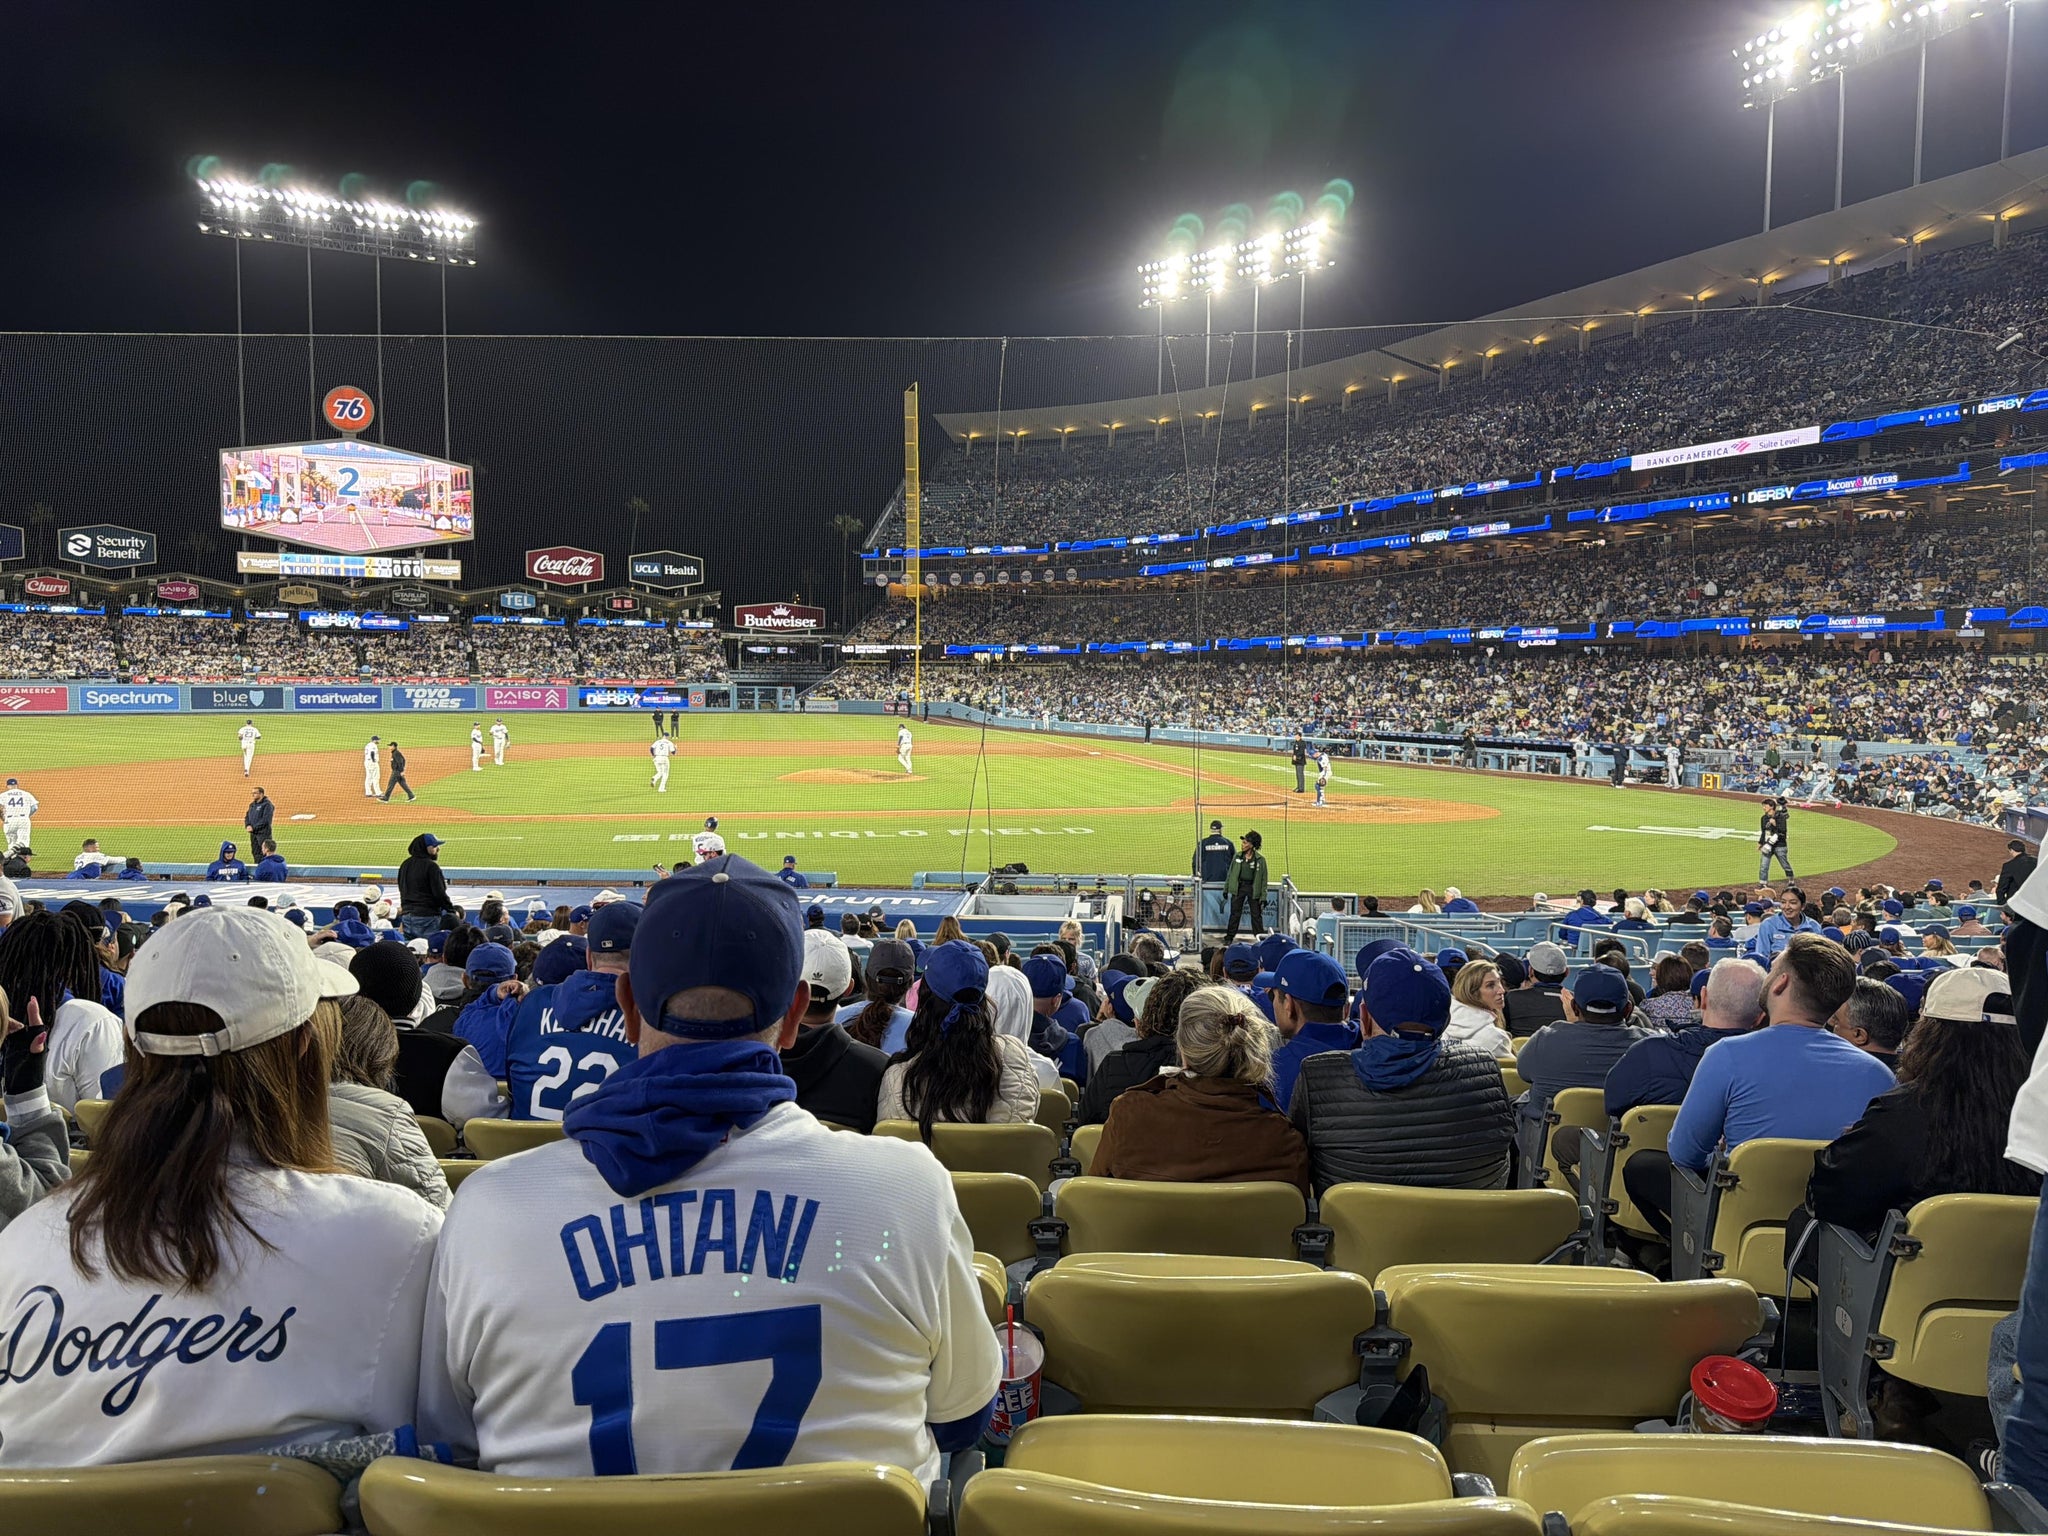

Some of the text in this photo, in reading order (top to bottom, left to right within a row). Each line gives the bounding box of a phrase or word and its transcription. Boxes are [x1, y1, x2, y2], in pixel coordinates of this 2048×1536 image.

[334, 398, 365, 420] 76
[1977, 397, 2025, 415] DERBY
[1647, 436, 1800, 467] BANK OF AMERICA Suite Level
[337, 466, 361, 497] 2
[1826, 479, 1856, 491] JACOBY
[1863, 474, 1898, 486] MEYERS
[1440, 487, 1463, 498] DERBY
[1748, 486, 1794, 503] DERBY
[96, 534, 148, 551] Security
[1420, 530, 1449, 543] DERBY
[98, 546, 141, 560] Benefit
[532, 554, 597, 576] Coca-Cola
[635, 564, 698, 576] UCLA Health
[27, 580, 68, 593] Churu
[505, 595, 532, 607] TEL
[308, 615, 357, 628] DERBY
[1763, 619, 1803, 630] DERBY
[1479, 629, 1506, 639] DERBY
[86, 691, 168, 708] Spectrum
[213, 690, 249, 703] blue
[299, 692, 378, 704] smartwater
[404, 688, 451, 698] TOYO
[494, 690, 542, 700] DAISO
[586, 693, 637, 706] DERBY
[691, 694, 702, 703] 76
[412, 698, 462, 709] TIRES
[8, 798, 24, 807] 44
[738, 827, 1094, 840] UNIQLO FIELD
[530, 1045, 620, 1121] 22
[560, 1188, 821, 1302] OHTANI
[0, 1285, 297, 1417] Dodgers
[571, 1304, 823, 1477] 17
